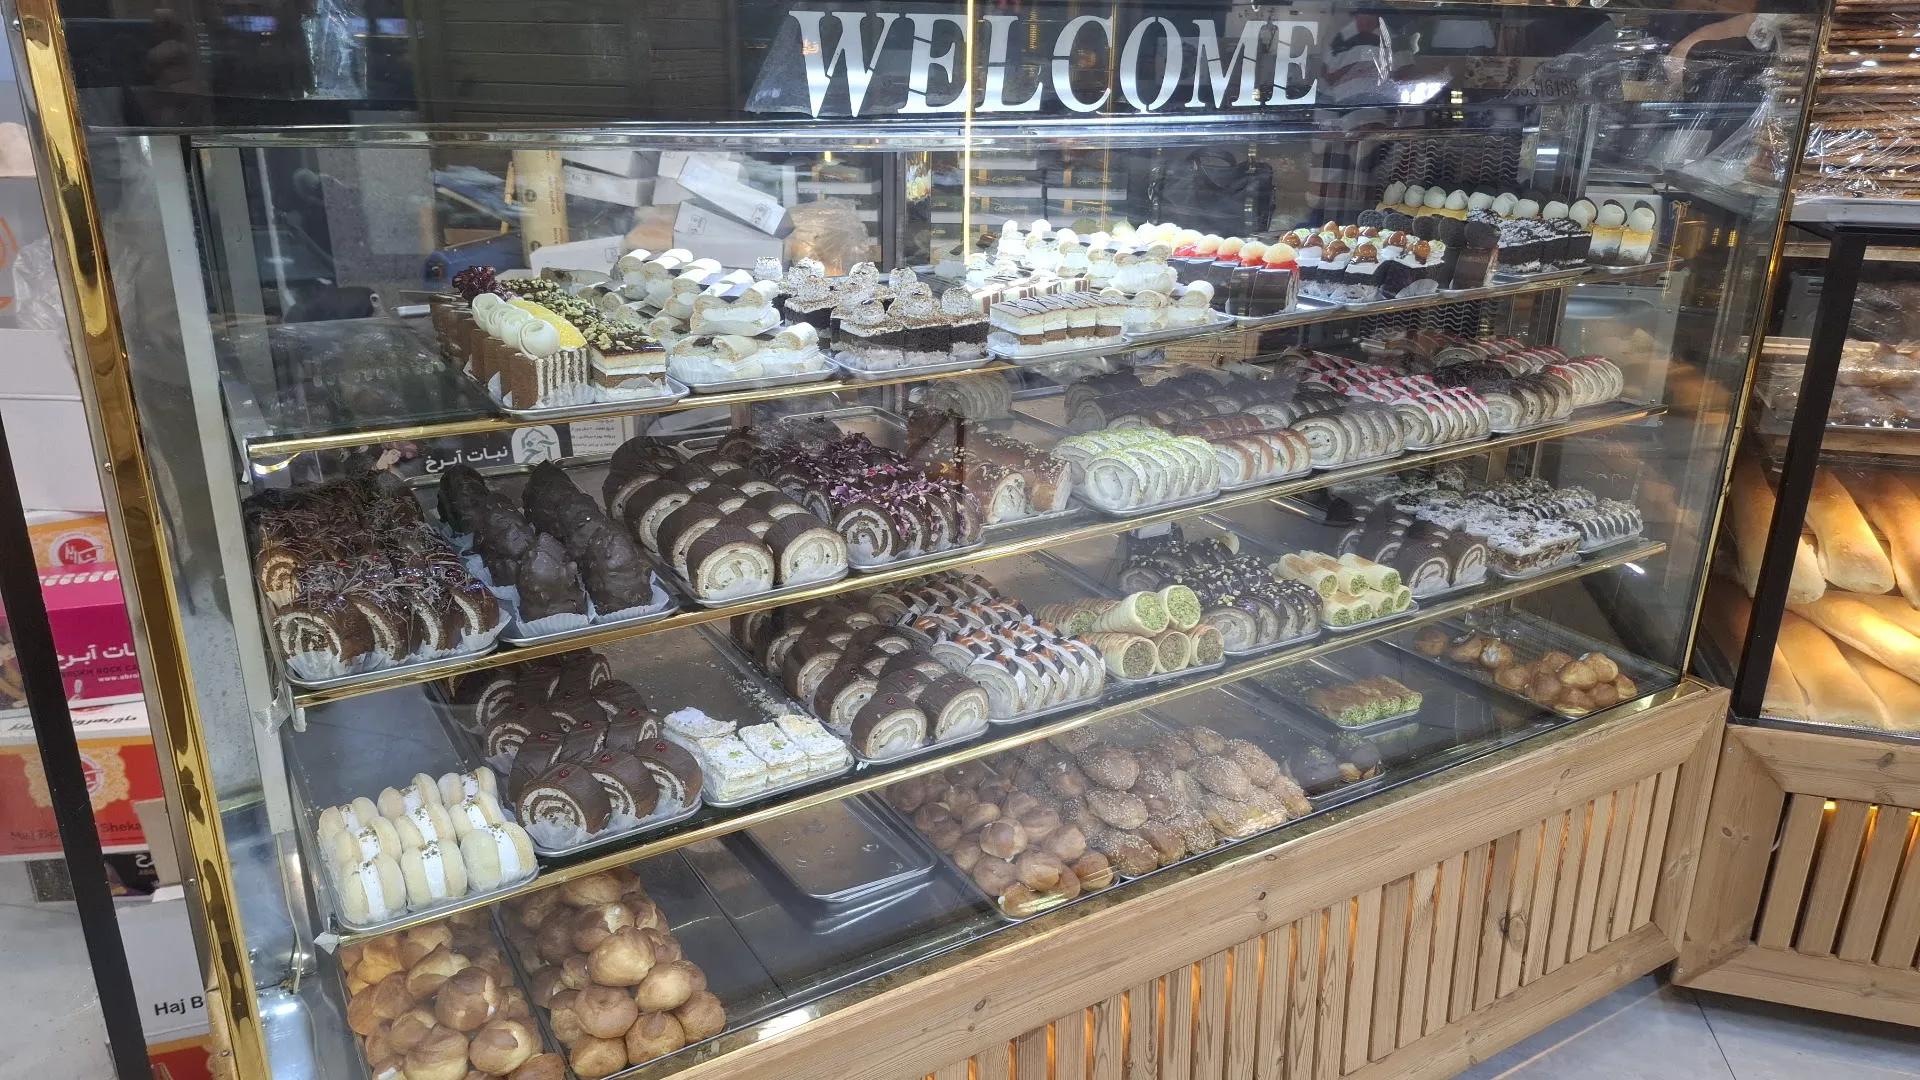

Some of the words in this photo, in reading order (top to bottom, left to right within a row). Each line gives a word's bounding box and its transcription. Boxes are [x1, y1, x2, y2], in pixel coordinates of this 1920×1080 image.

[789, 6, 1320, 119] WELCOME
[467, 445, 508, 463] نبات
[100, 820, 142, 835] Sheka
[154, 999, 187, 1018] Haj
